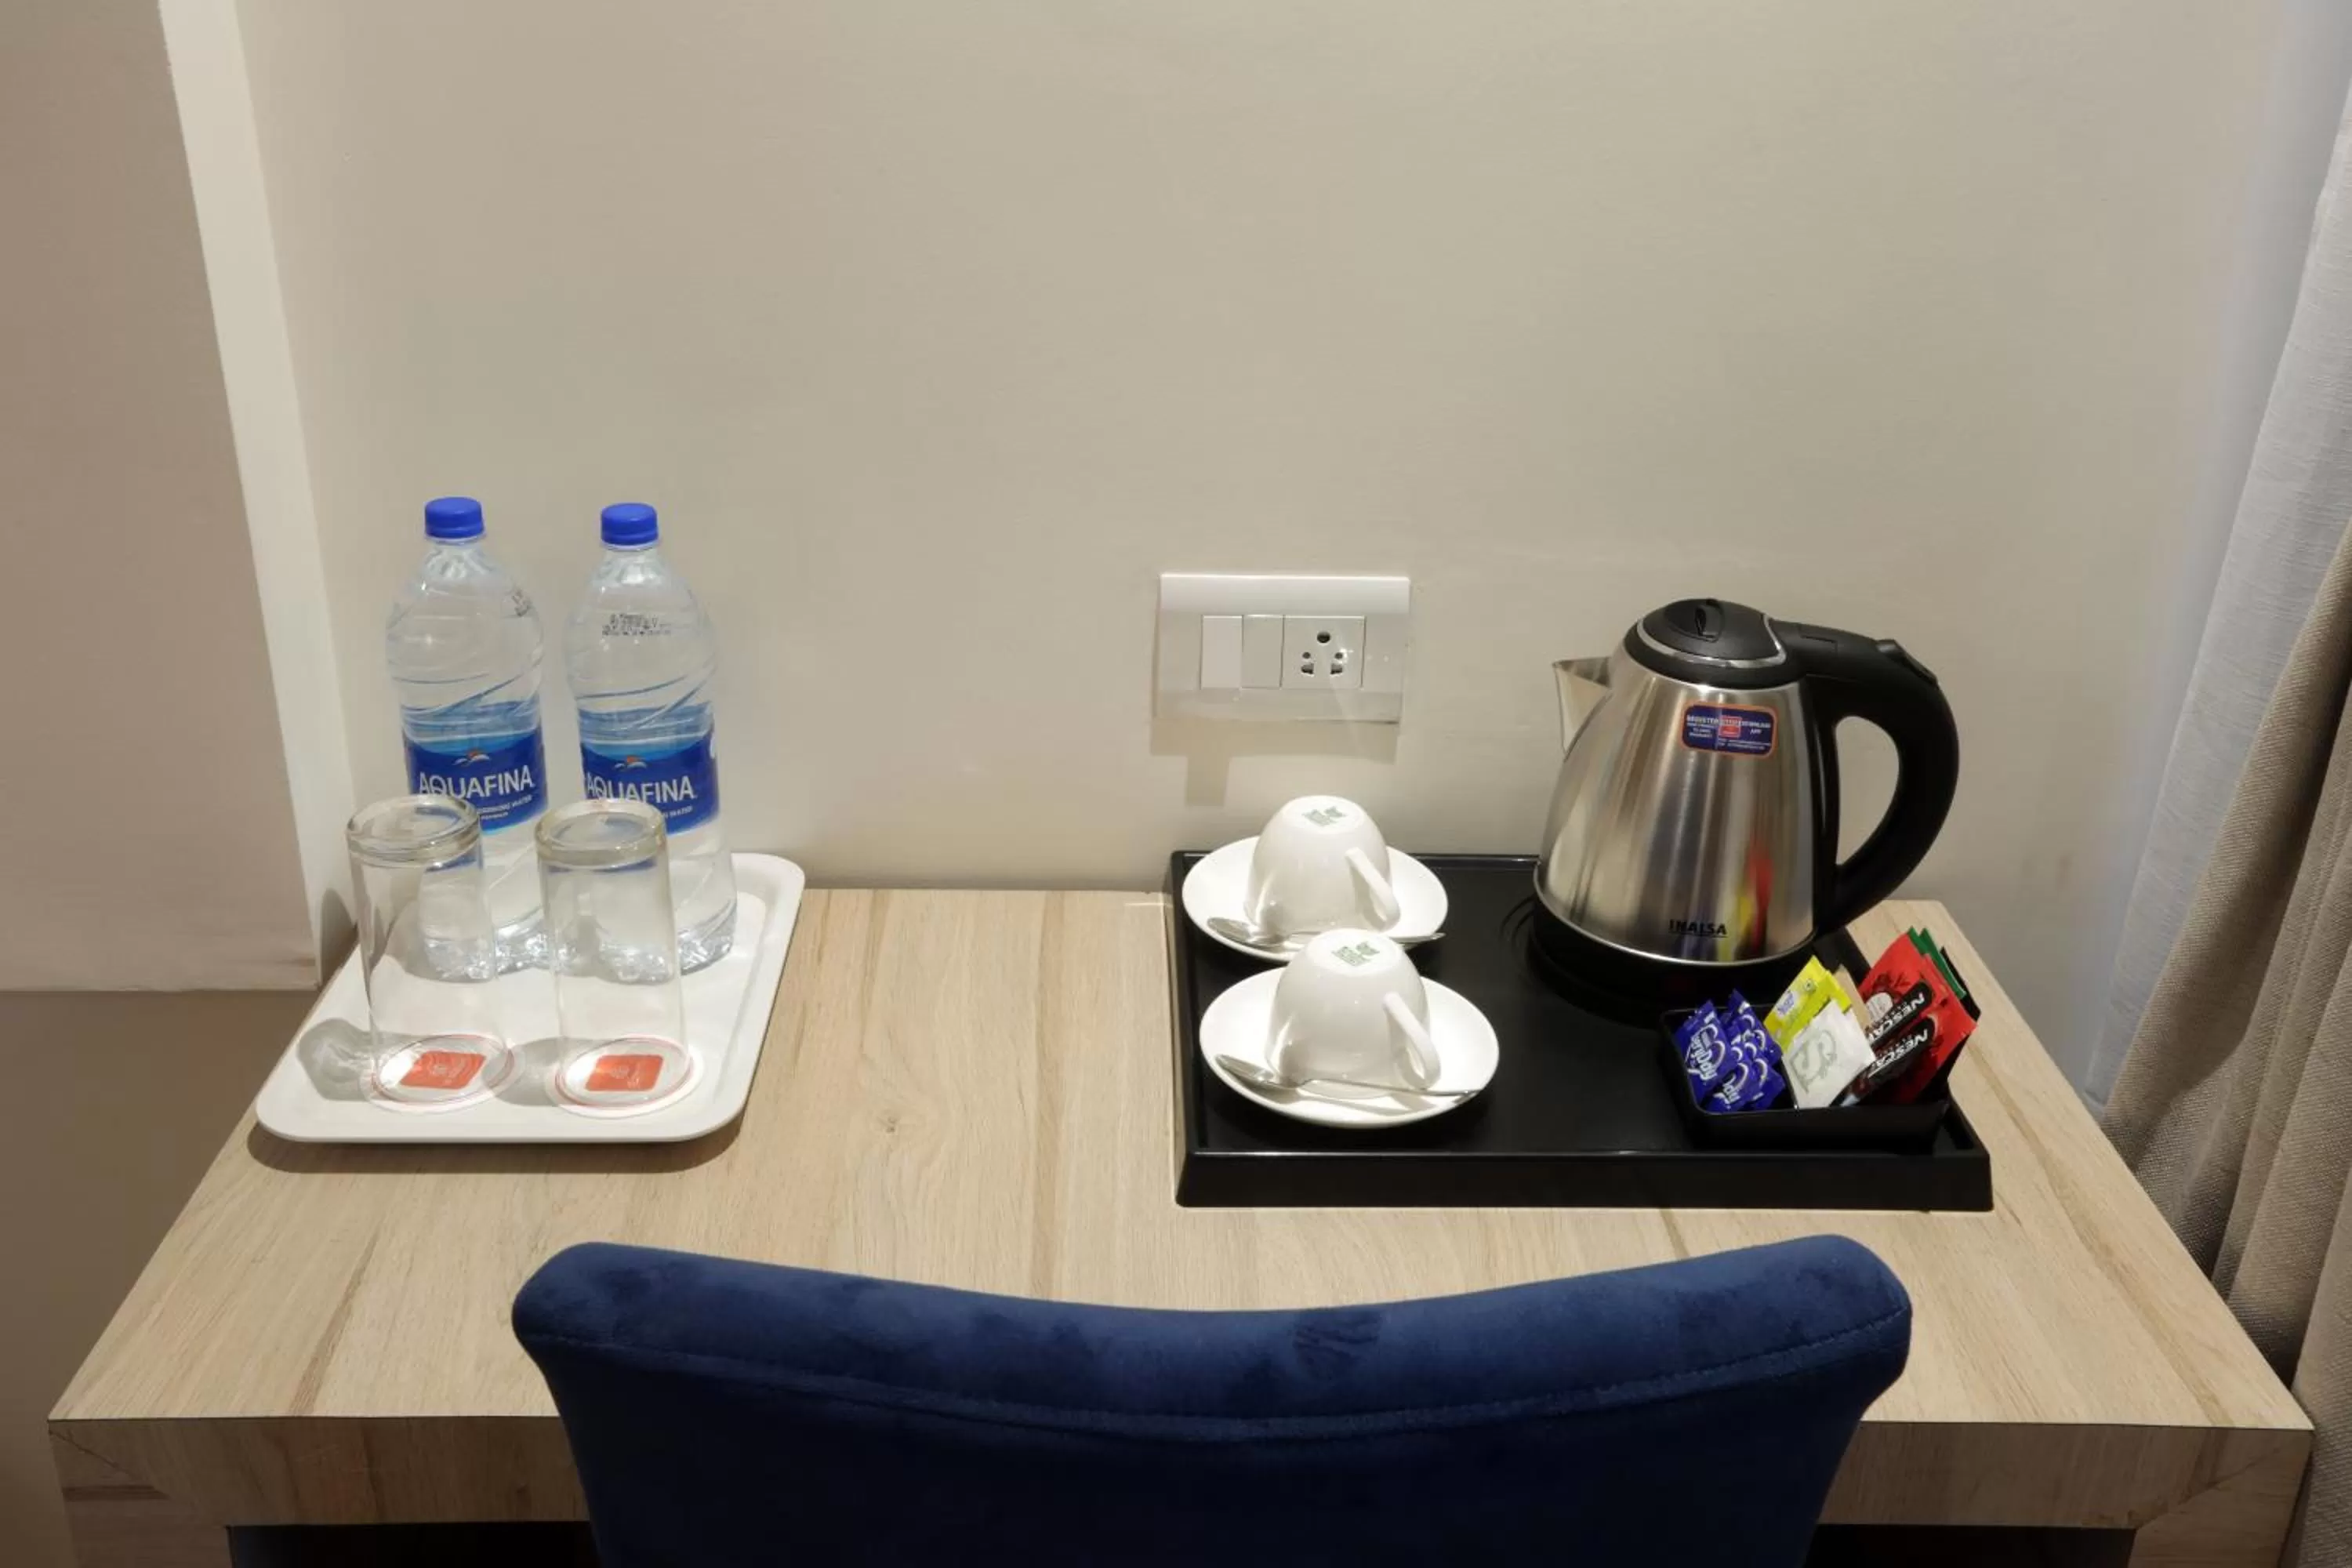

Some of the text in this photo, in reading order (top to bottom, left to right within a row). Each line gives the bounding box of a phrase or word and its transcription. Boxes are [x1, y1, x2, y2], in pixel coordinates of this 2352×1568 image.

[419, 764, 534, 800] AQUAFINA
[586, 772, 695, 804] AQUAFINA
[1868, 992, 1926, 1044] NESCAF
[1869, 1028, 1929, 1077] NESCA
